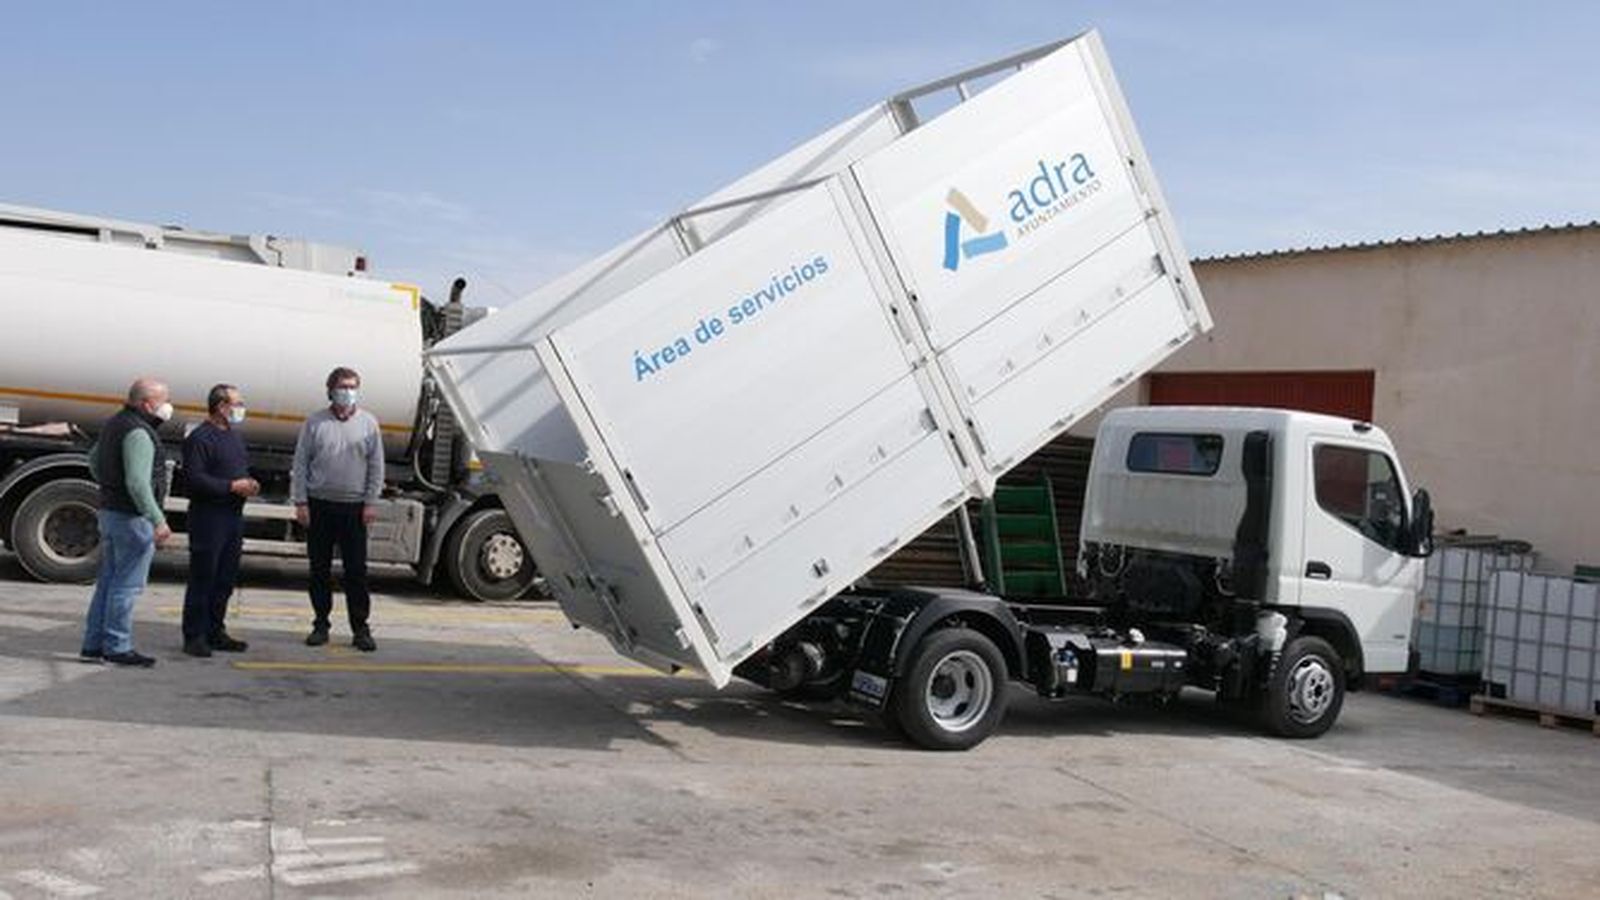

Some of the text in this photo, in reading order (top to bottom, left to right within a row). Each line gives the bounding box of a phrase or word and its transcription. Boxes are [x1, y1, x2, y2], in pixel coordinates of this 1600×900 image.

[1008, 152, 1095, 222] adra
[1017, 179, 1102, 238] AYUNTAMIENTO
[633, 254, 829, 381] Área de servicios
